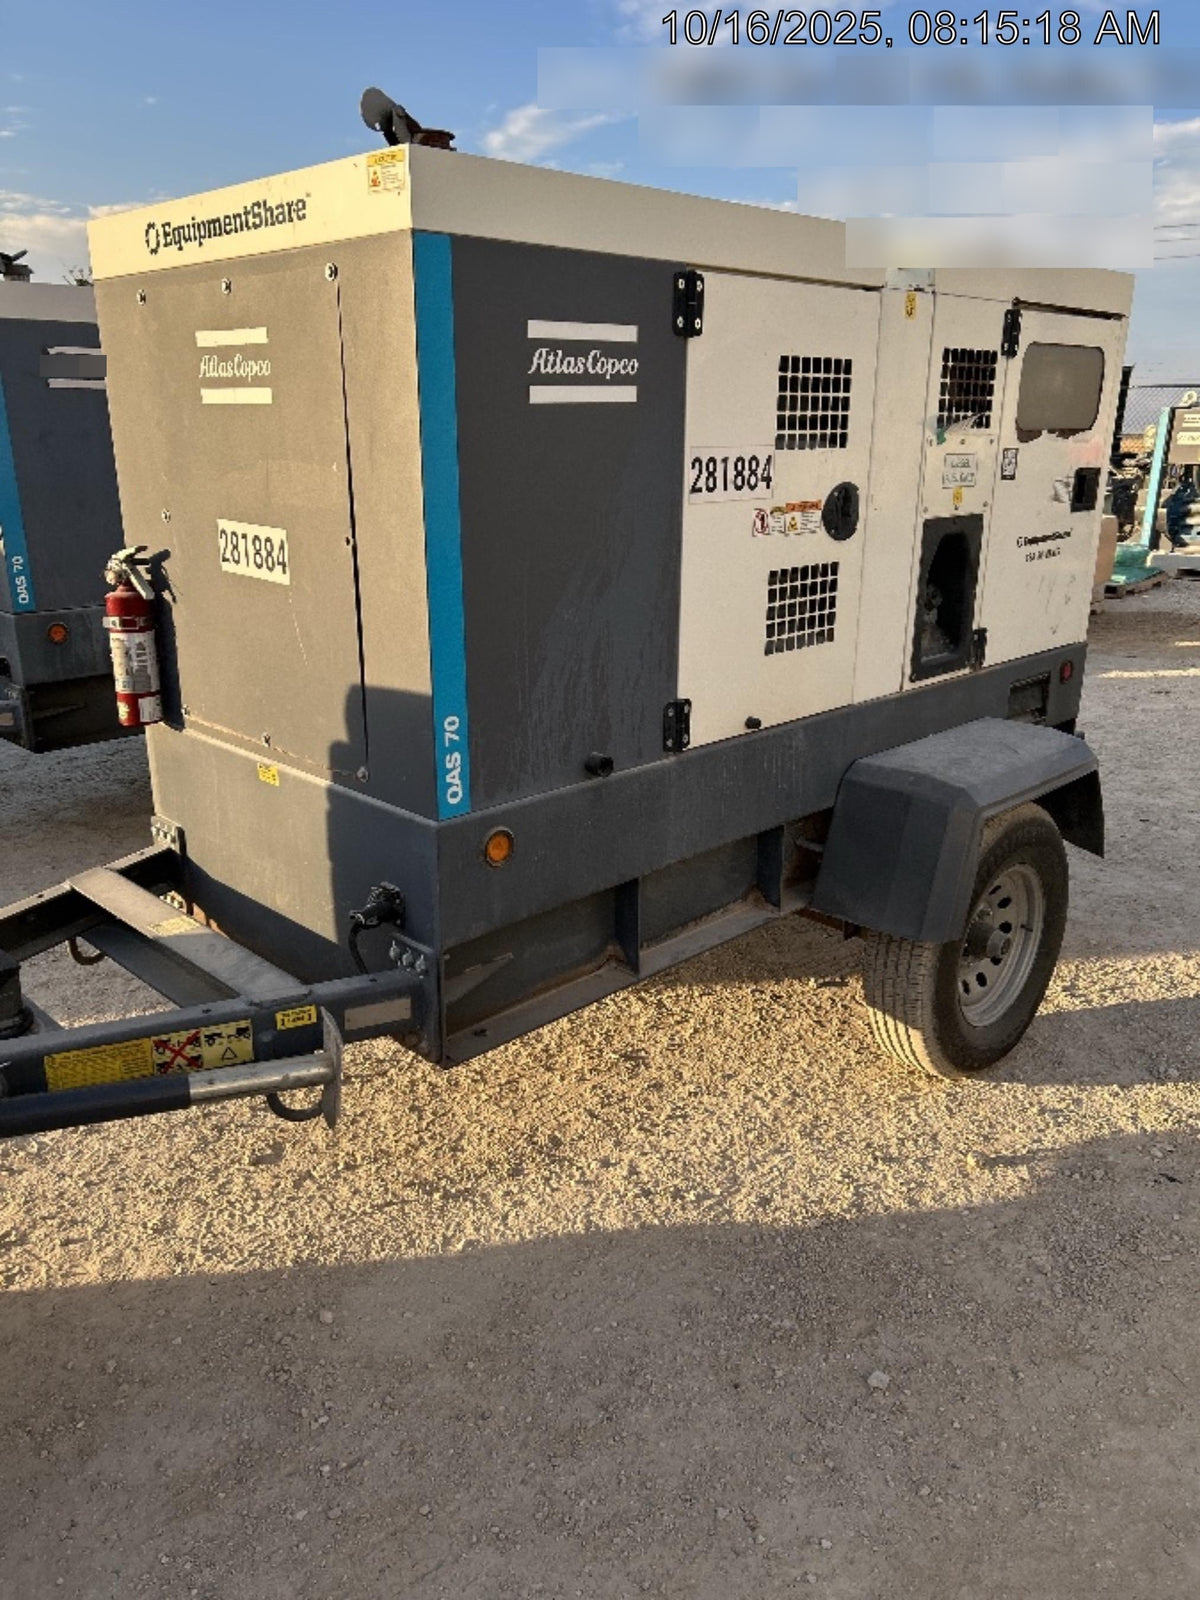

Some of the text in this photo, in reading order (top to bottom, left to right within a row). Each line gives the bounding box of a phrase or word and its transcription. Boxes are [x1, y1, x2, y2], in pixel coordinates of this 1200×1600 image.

[161, 198, 307, 251] EquipmentShare
[690, 454, 773, 494] 281884
[219, 528, 287, 575] 281884
[11, 555, 29, 604] QAS 70
[443, 715, 463, 805] QAS 70
